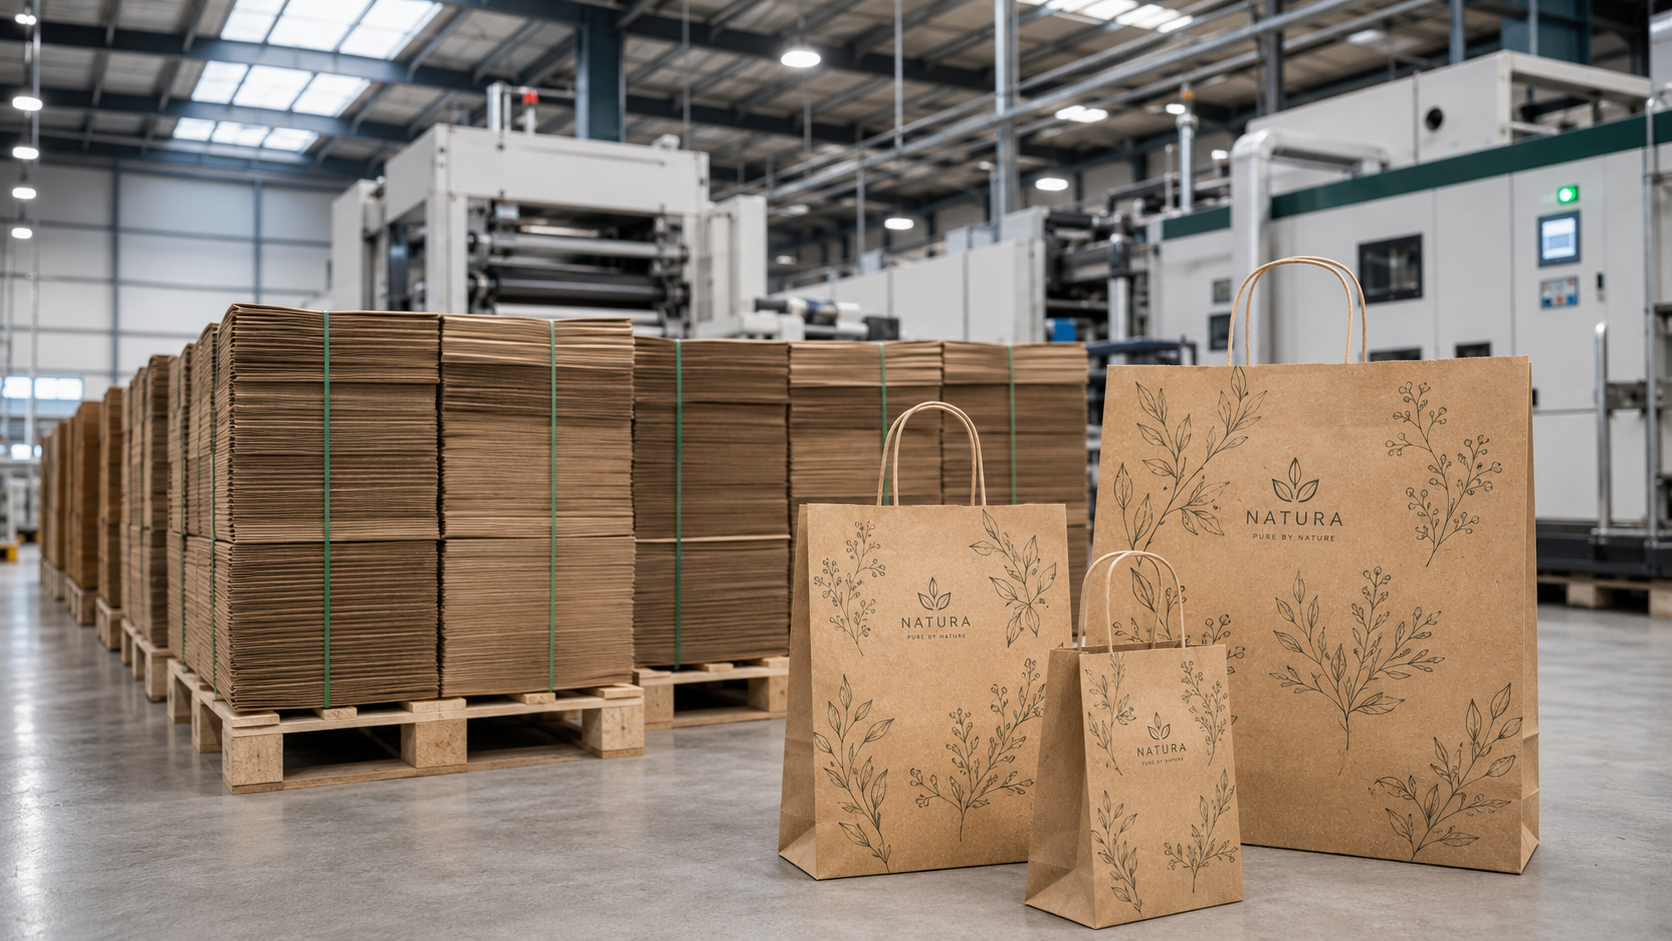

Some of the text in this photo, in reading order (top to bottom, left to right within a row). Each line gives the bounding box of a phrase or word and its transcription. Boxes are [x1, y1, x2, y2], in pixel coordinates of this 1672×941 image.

[1246, 510, 1343, 526] NATURA
[1297, 534, 1335, 542] NATURE
[901, 616, 971, 629] NATURA
[1136, 742, 1187, 757] NATURA
